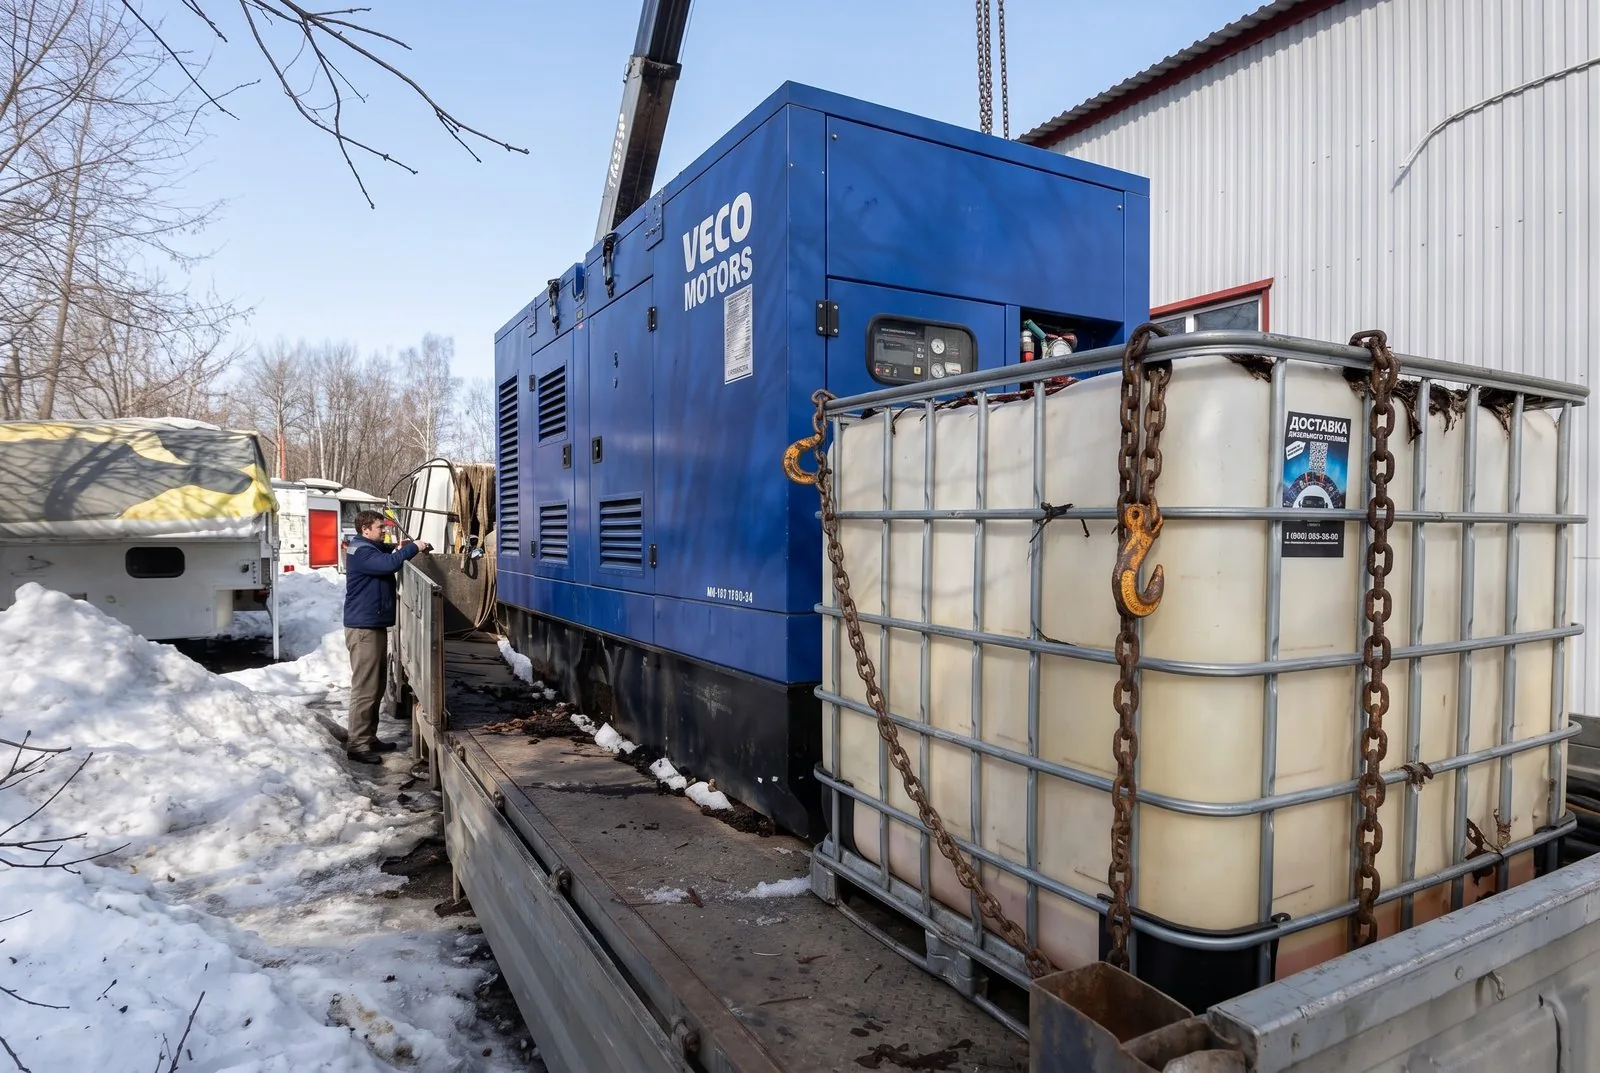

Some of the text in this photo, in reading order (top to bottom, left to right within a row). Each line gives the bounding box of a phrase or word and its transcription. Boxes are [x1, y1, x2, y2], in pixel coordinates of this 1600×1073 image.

[682, 192, 752, 273] VECO
[684, 246, 753, 312] MOTORS
[1289, 416, 1348, 435] ДОСТАВКА
